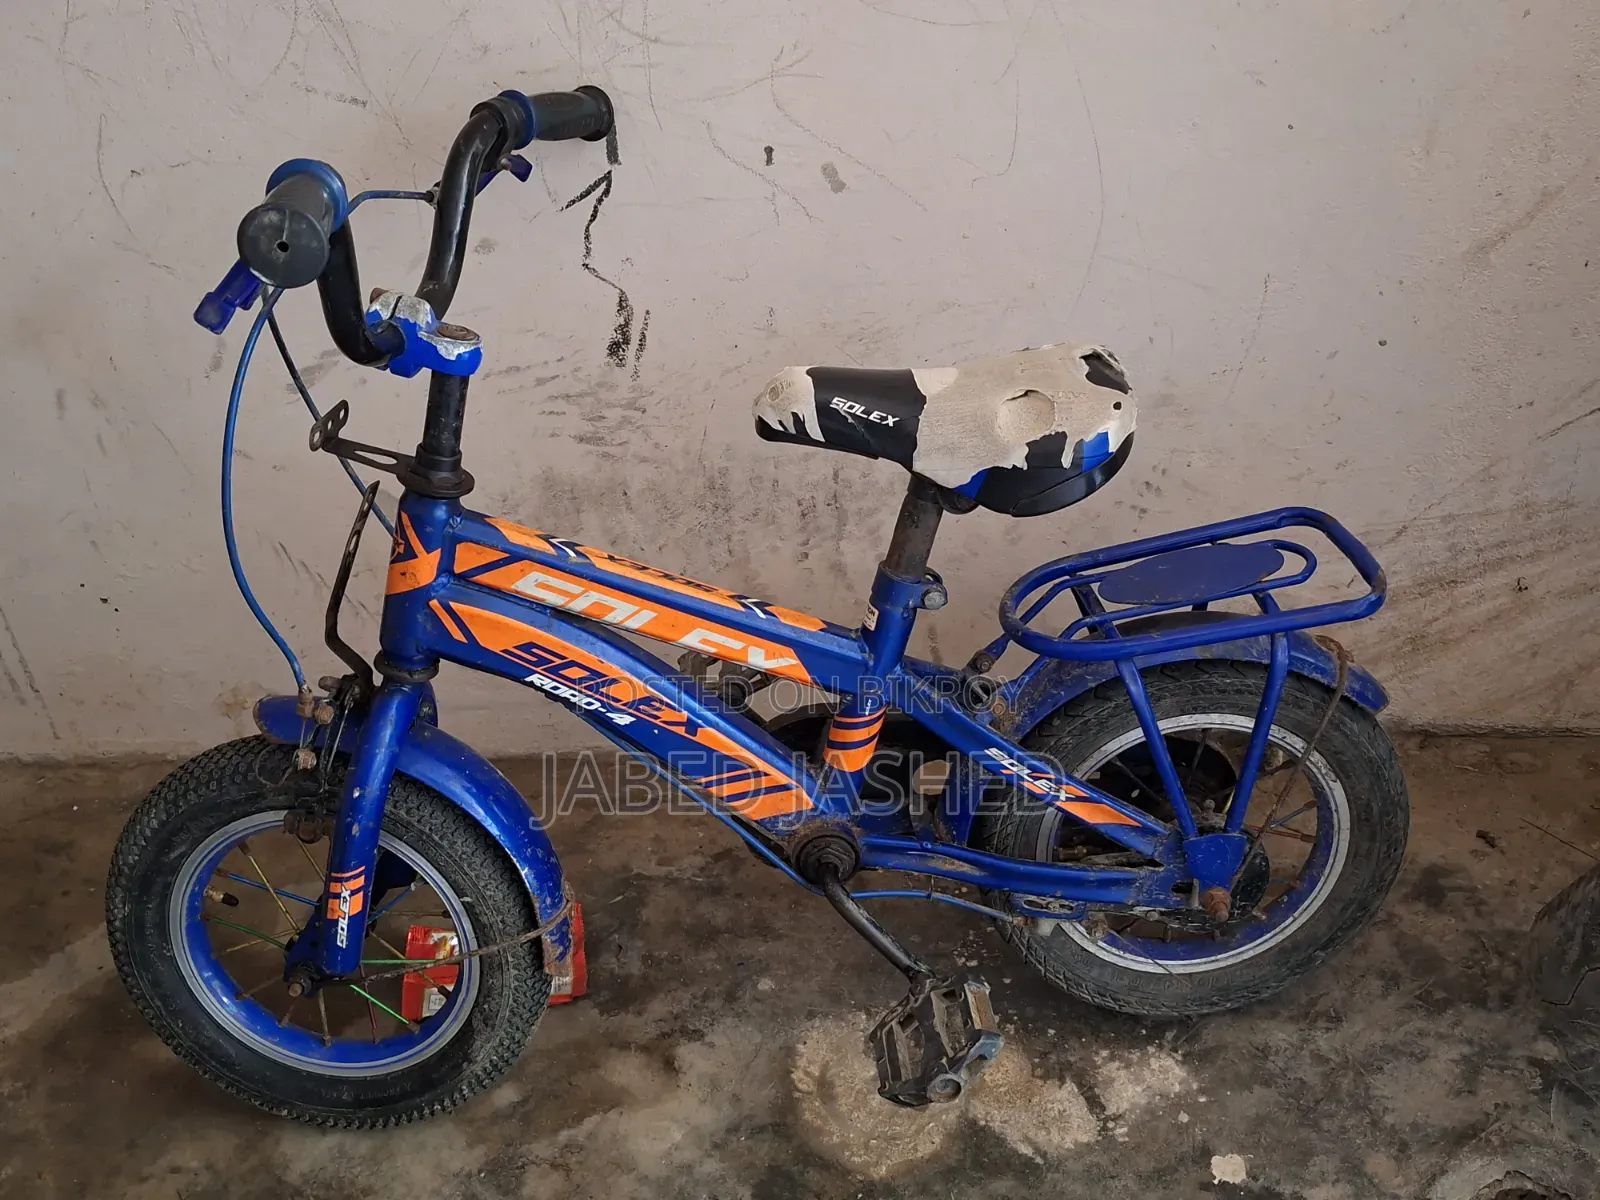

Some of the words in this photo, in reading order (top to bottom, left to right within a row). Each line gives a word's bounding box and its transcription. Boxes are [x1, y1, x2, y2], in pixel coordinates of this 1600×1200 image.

[829, 396, 900, 427] SOLEX
[500, 641, 700, 738] SOLEX
[984, 747, 1076, 802] SOLEX
[337, 882, 351, 949] SOLEX
